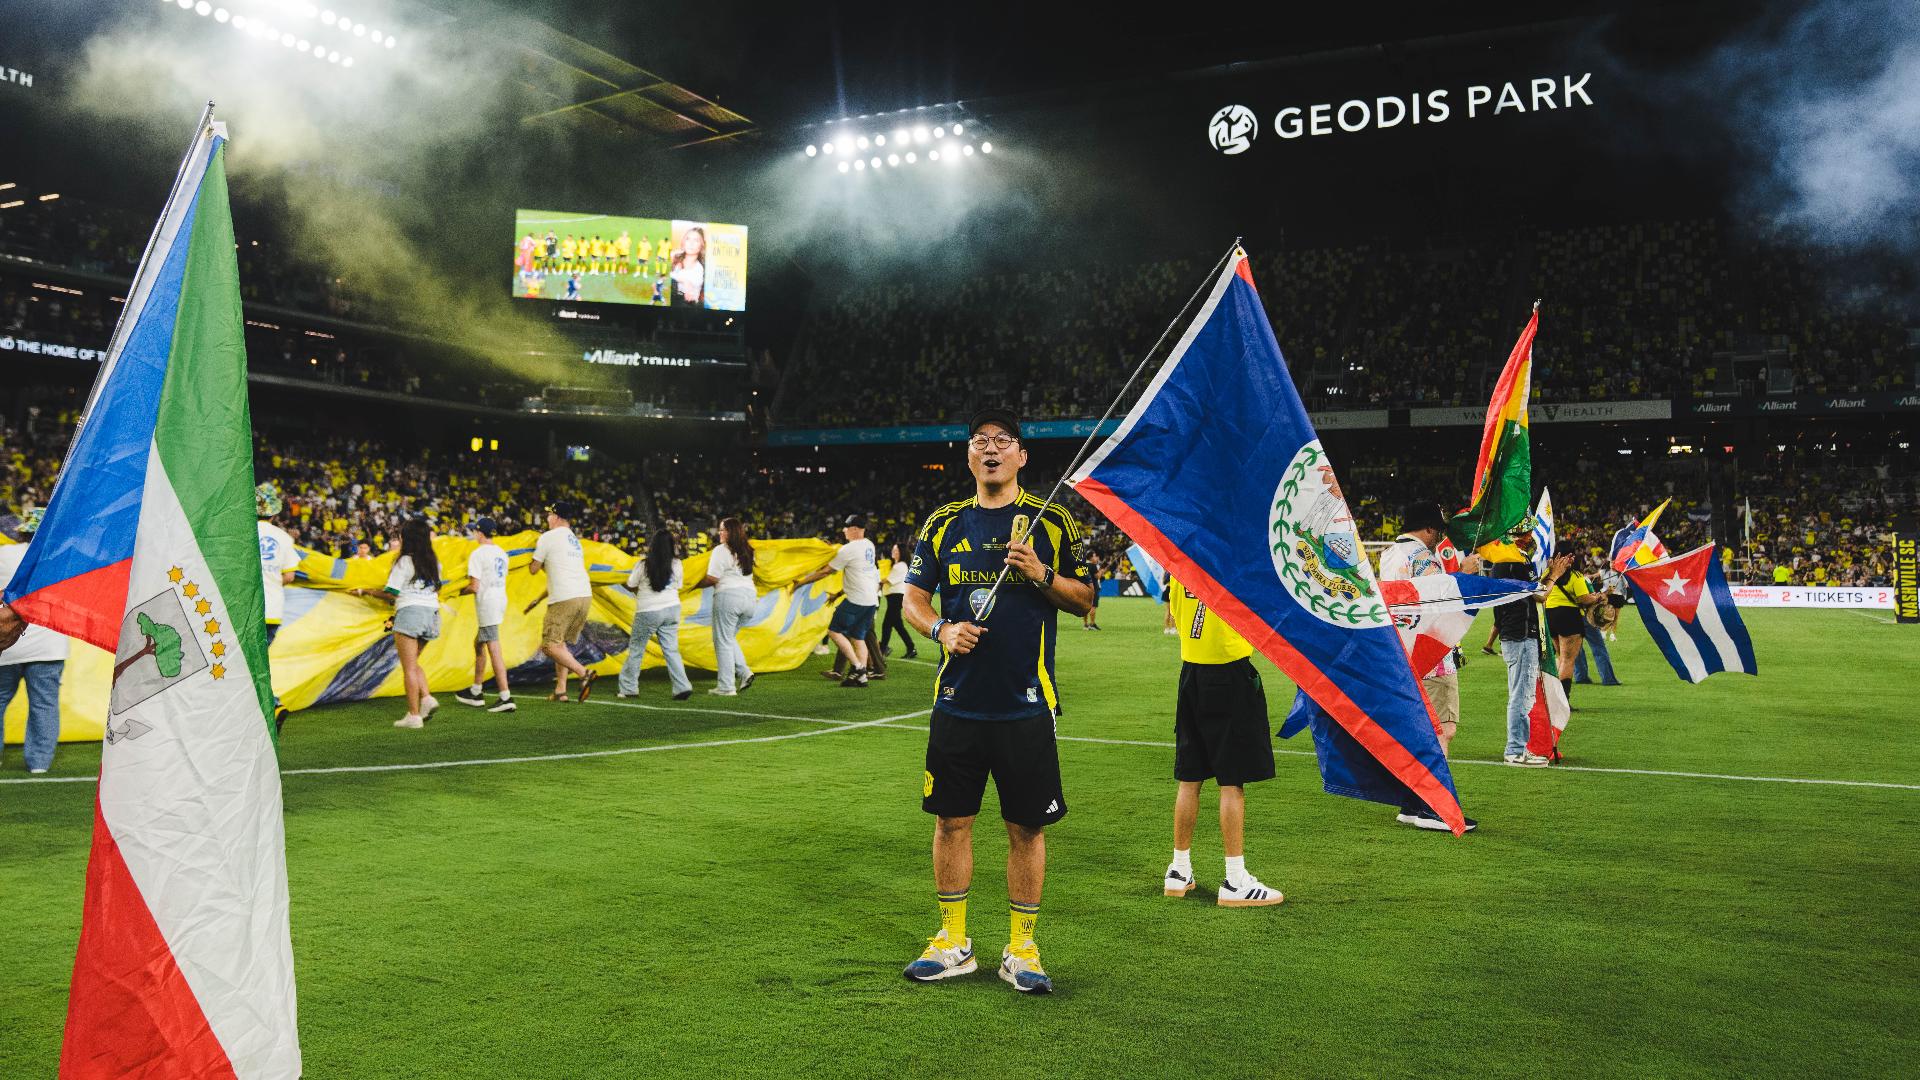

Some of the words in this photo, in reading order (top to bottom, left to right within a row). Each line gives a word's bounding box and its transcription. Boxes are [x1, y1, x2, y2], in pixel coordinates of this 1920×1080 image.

[1274, 89, 1450, 139] GEODIS
[1467, 72, 1594, 118] PARK
[16, 339, 41, 354] THE
[41, 343, 78, 359] HOME
[78, 348, 96, 361] OF
[589, 349, 642, 367] Alliant
[642, 356, 691, 367] TERRACE
[1697, 403, 1733, 413] Alliant
[1762, 400, 1798, 411] Alliant
[1829, 398, 1866, 409] Alliant
[1563, 407, 1614, 418] HEALTH
[1302, 545, 1312, 561] SUB
[1309, 563, 1327, 586] UMBRA
[1900, 557, 1919, 618] NASHVILLE
[1782, 591, 1791, 601] 2
[1804, 592, 1863, 603] TICKETS
[1877, 592, 1888, 603] 2
